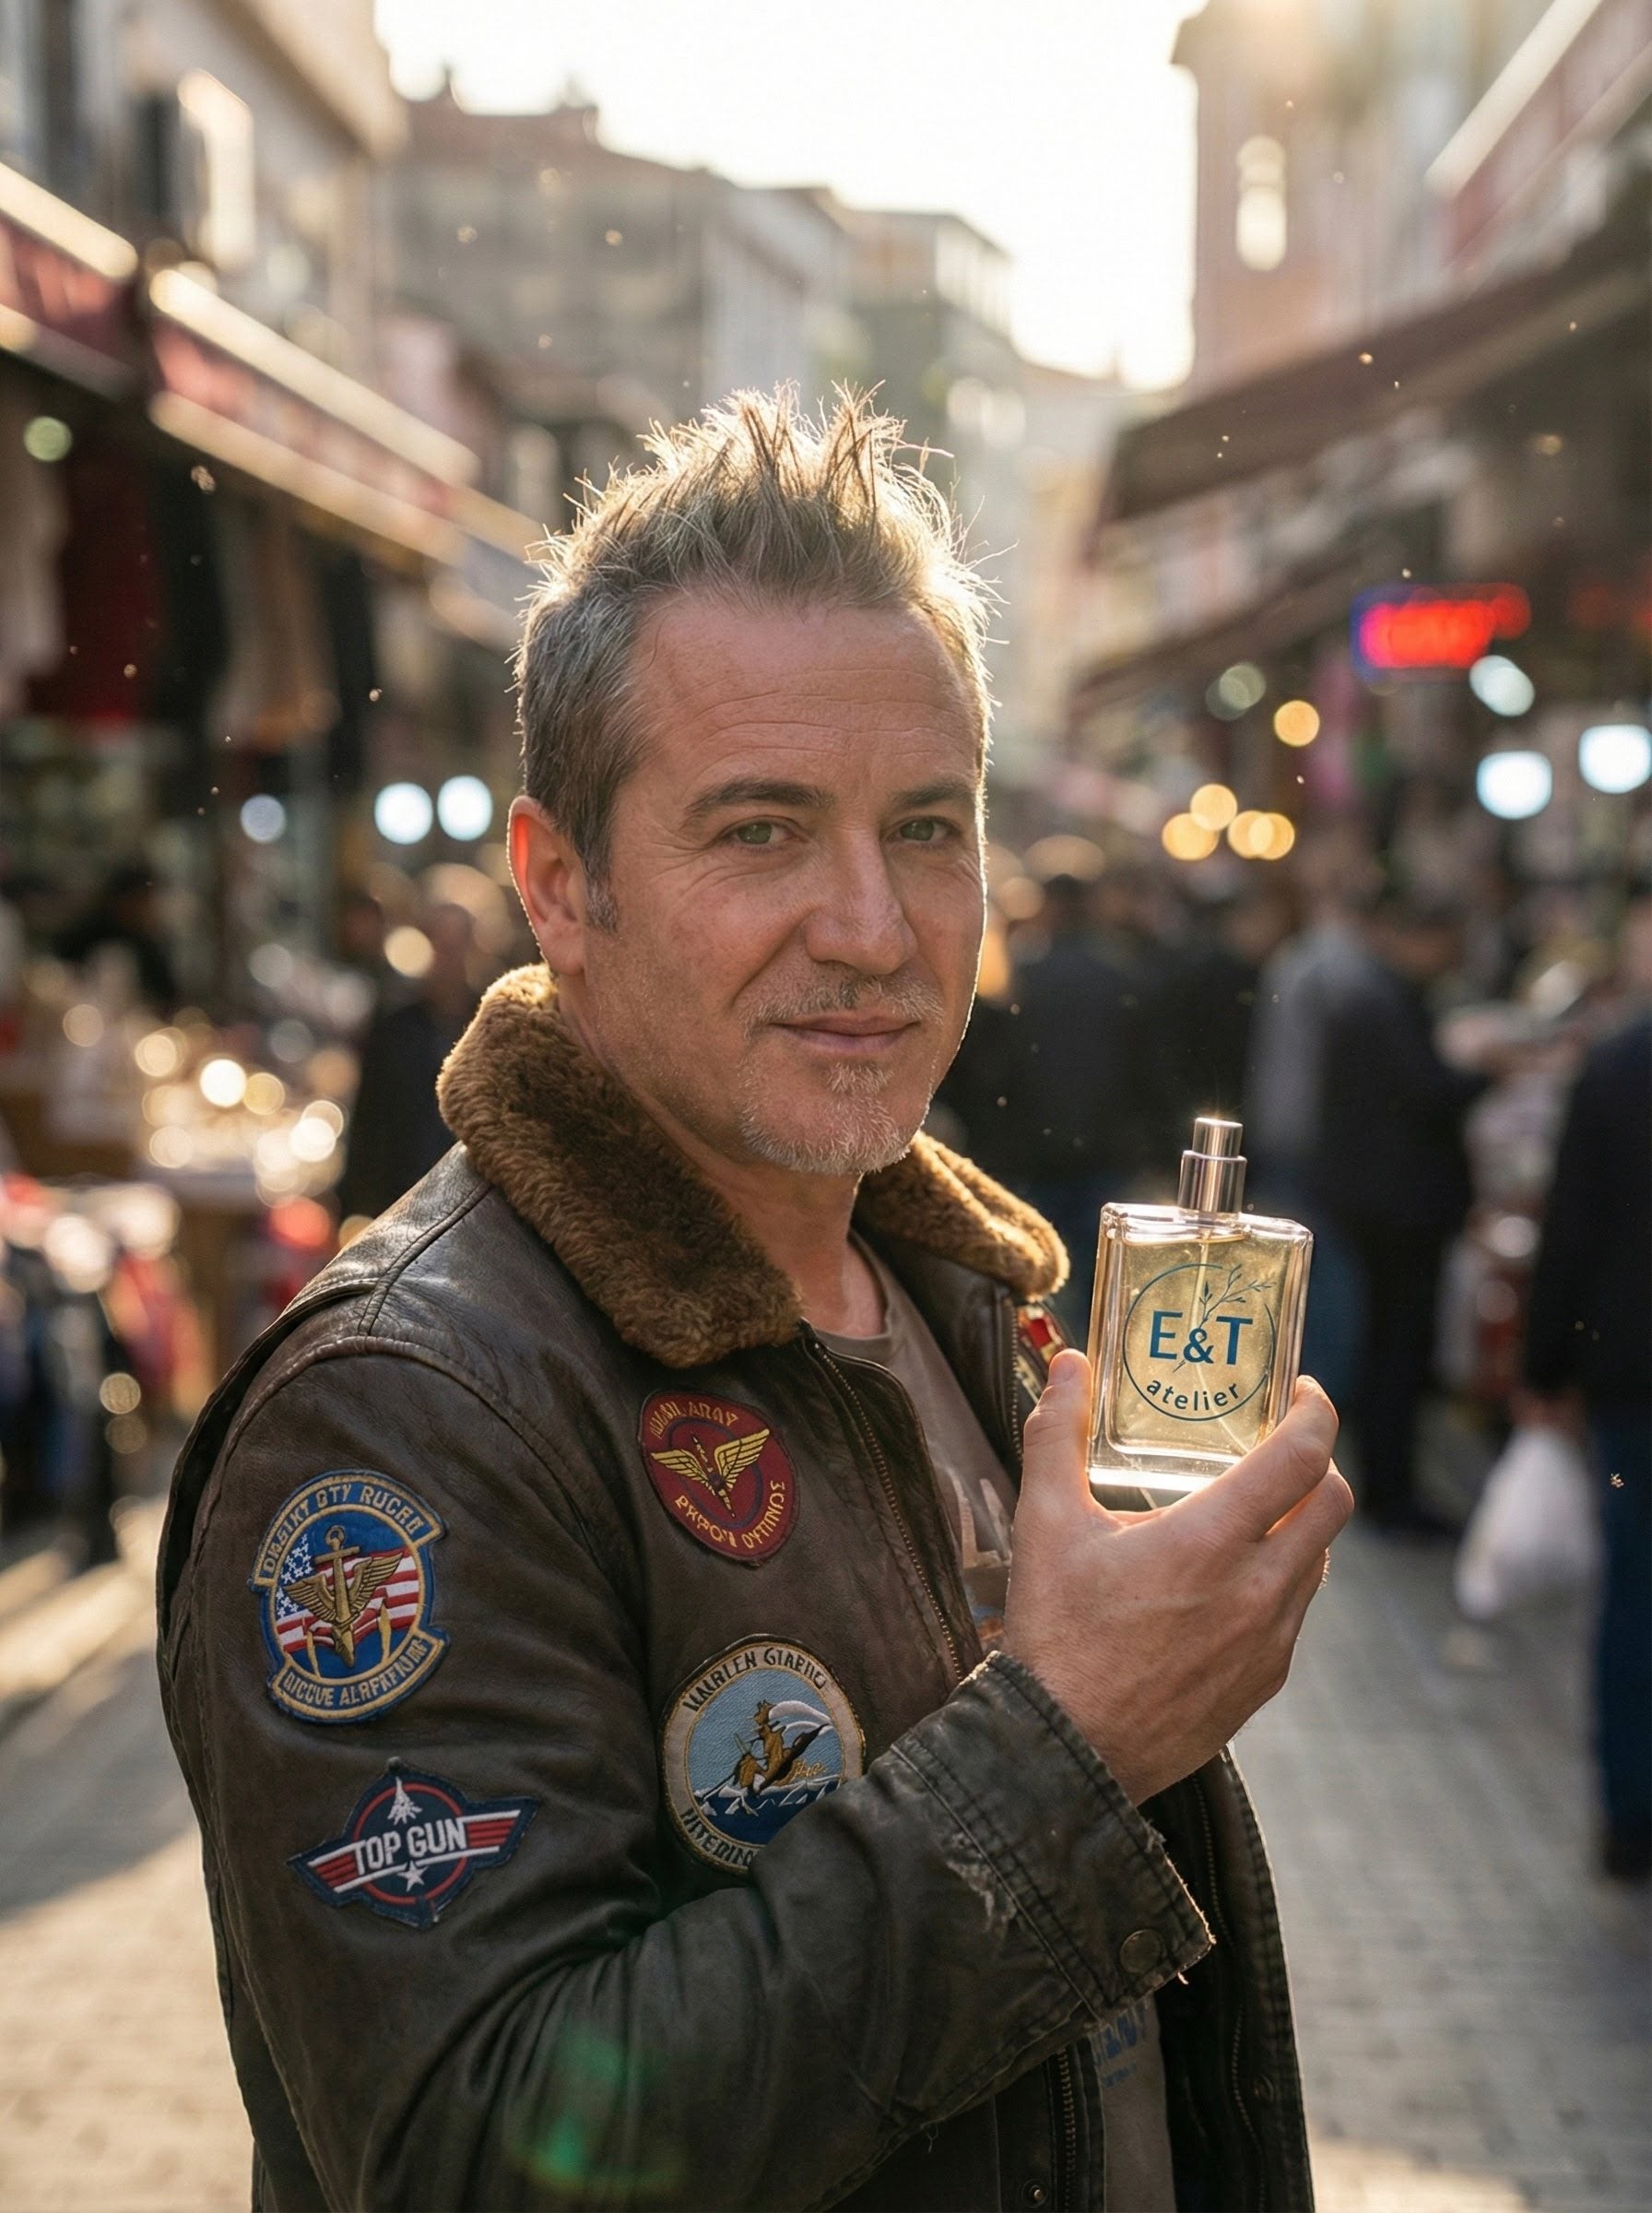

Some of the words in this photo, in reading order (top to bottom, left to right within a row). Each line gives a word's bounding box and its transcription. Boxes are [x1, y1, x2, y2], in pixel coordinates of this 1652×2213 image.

[1149, 1309, 1254, 1366] E&T
[1146, 1379, 1239, 1411] atelier
[354, 1831, 402, 1876] TOP
[407, 1817, 467, 1858] GUN
